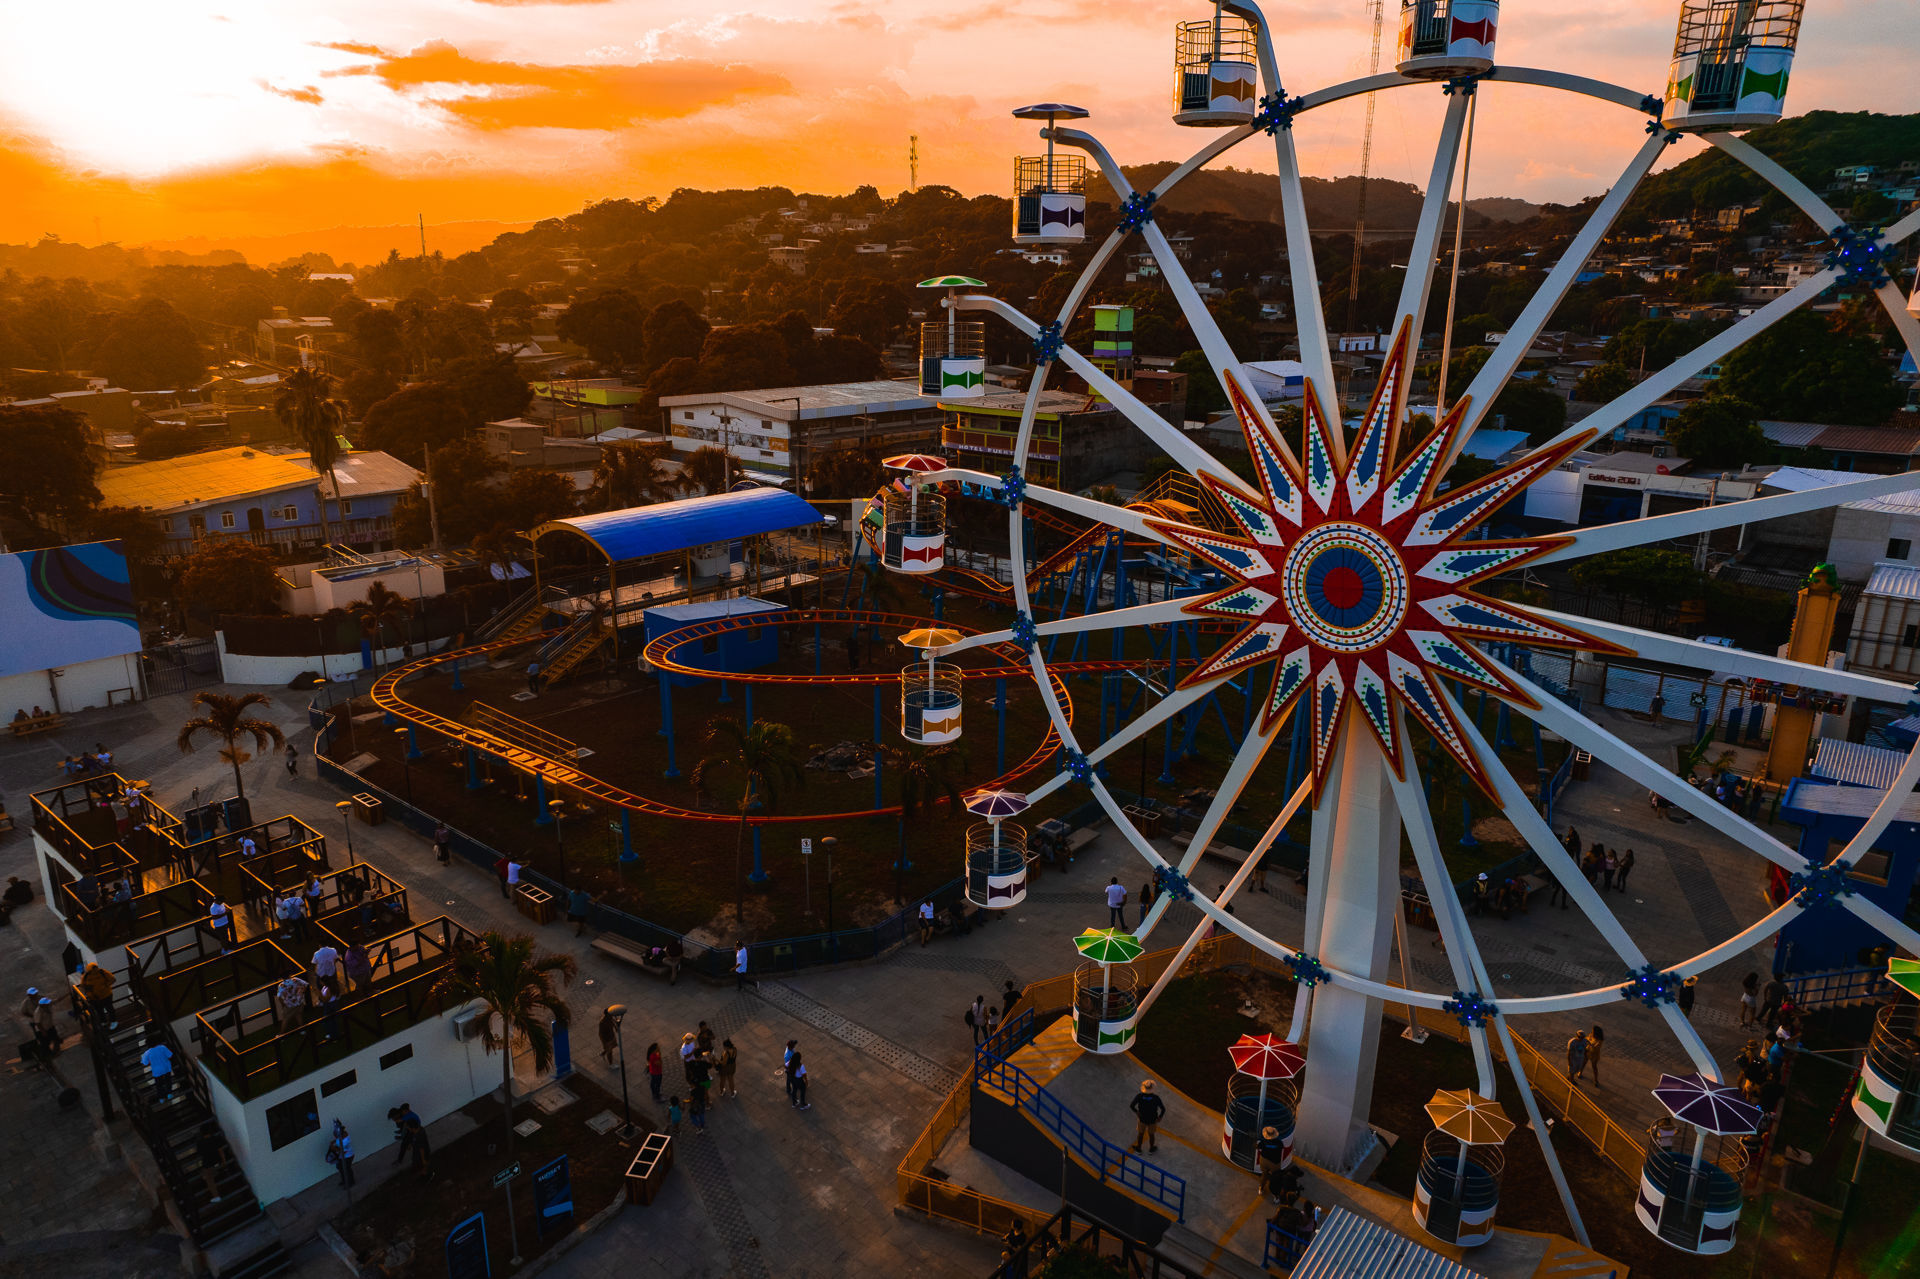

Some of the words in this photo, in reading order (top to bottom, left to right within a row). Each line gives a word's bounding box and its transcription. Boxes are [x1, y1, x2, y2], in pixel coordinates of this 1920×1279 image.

[958, 444, 983, 452] HOTEL
[987, 447, 1015, 456] PUERT
[1028, 452, 1051, 460] ELLO
